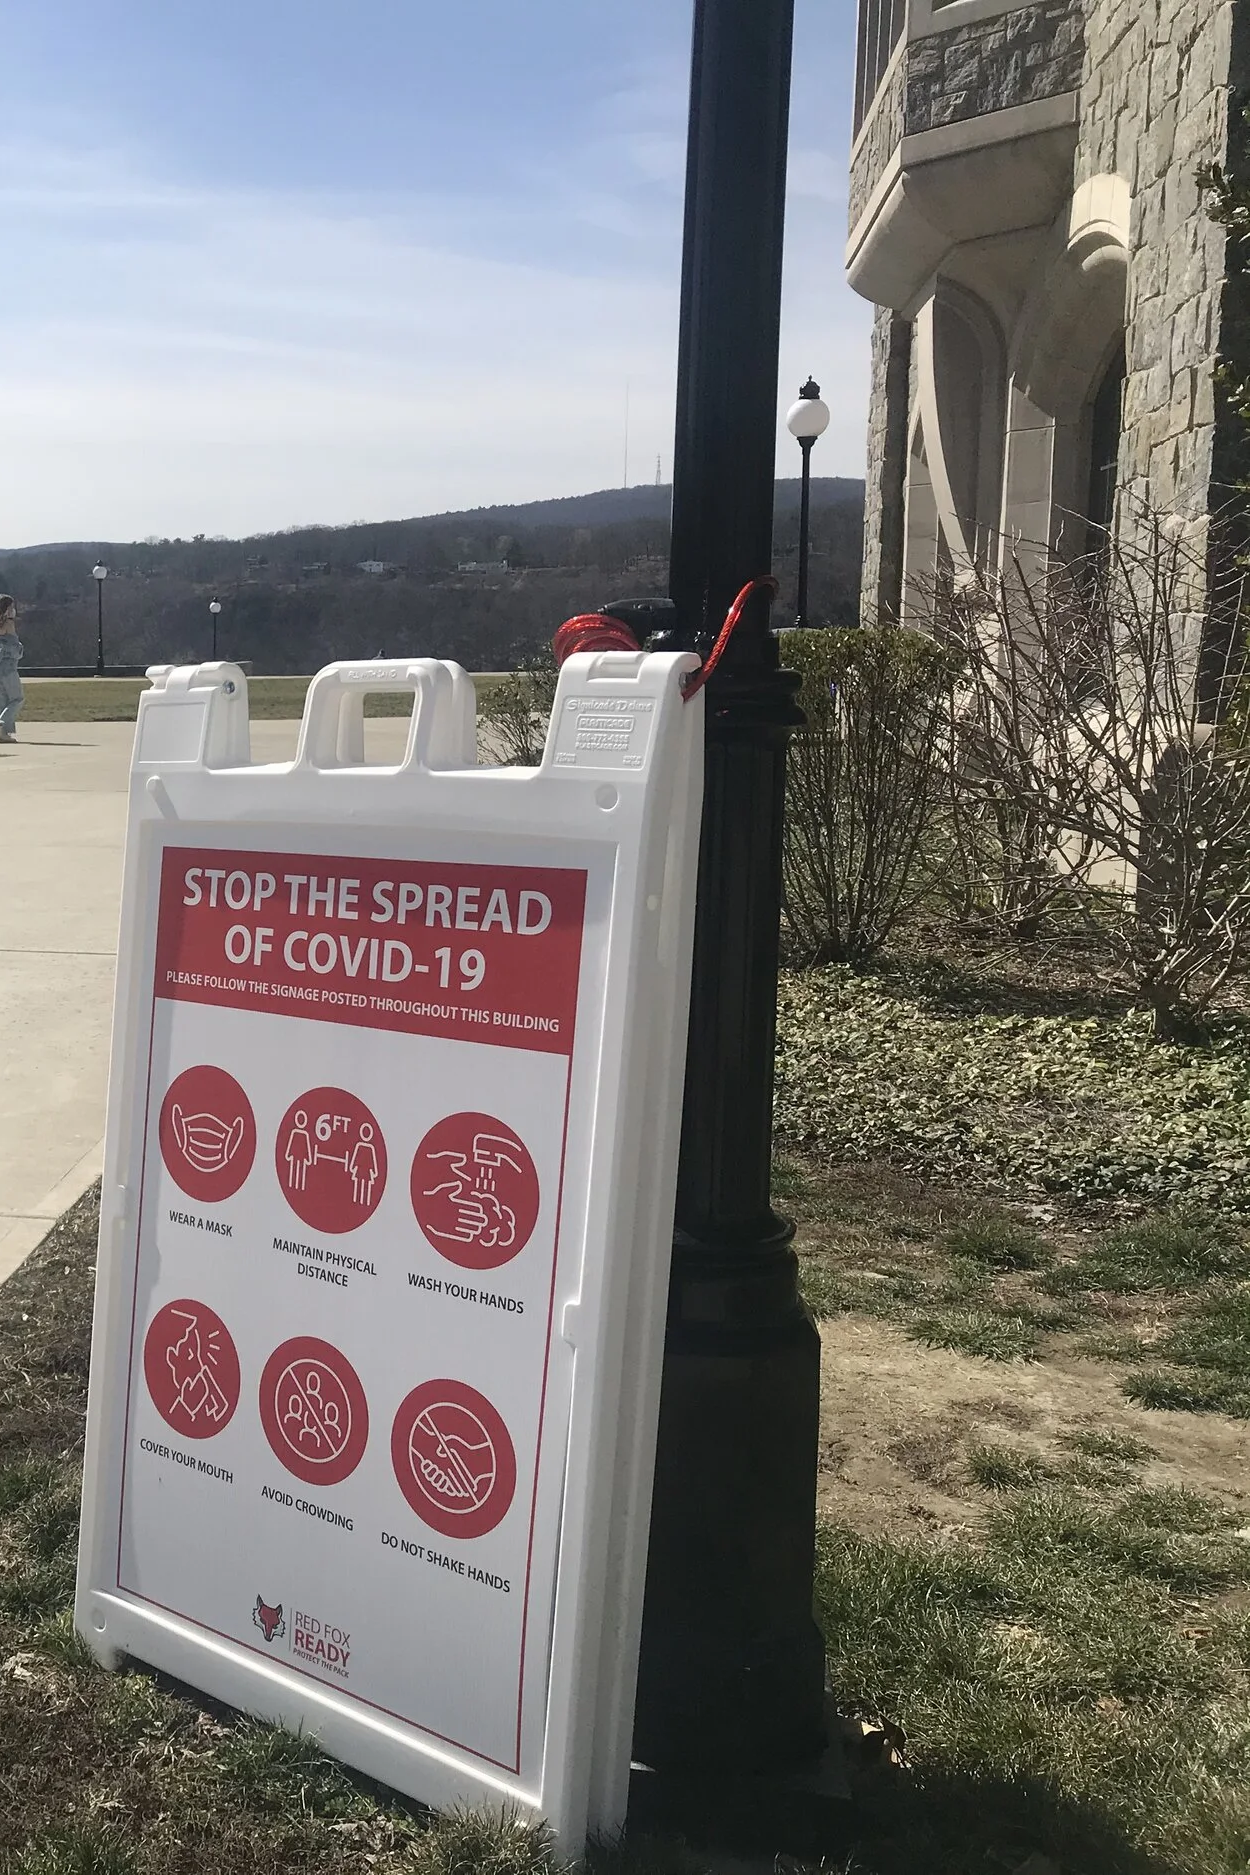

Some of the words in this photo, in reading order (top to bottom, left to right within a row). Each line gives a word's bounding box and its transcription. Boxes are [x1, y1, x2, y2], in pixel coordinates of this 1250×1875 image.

[182, 867, 276, 912] STOP
[284, 874, 361, 919] THE
[370, 880, 553, 936] SPREAD
[224, 924, 274, 966] OF
[283, 930, 486, 991] COVID-19
[166, 970, 202, 987] PLEASE
[204, 974, 247, 992] FOLLOW
[248, 980, 269, 995] THE
[270, 983, 319, 1001] SIGNAGE
[321, 990, 367, 1008] POSTED
[370, 996, 459, 1020] THROUGHOUT
[460, 1008, 490, 1024] THIS
[493, 1011, 560, 1033] BUILDING
[169, 1210, 195, 1226] WEAR
[196, 1217, 204, 1230] A
[205, 1218, 233, 1237] MASK
[272, 1237, 324, 1261] MAINTAIN
[325, 1249, 377, 1276] PHYSICAL
[297, 1262, 348, 1287] DISTANCE
[407, 1272, 442, 1294] WASH
[443, 1282, 478, 1303] YOUR
[479, 1291, 524, 1314] HANDS
[140, 1438, 170, 1459] COVER
[171, 1449, 196, 1471] YOUR
[197, 1459, 233, 1484] MOUTH
[261, 1485, 294, 1507] AVOID
[296, 1498, 354, 1531] CROWDING
[381, 1532, 398, 1550] DO
[401, 1539, 425, 1560] NOT
[427, 1550, 465, 1576] SHAKE
[467, 1565, 511, 1593] HANDS
[295, 1611, 321, 1634] RED
[324, 1624, 350, 1649] FOX
[295, 1629, 350, 1667] READY
[293, 1648, 321, 1665] PROTECT
[321, 1661, 332, 1671] THE
[333, 1667, 349, 1678] PACK
